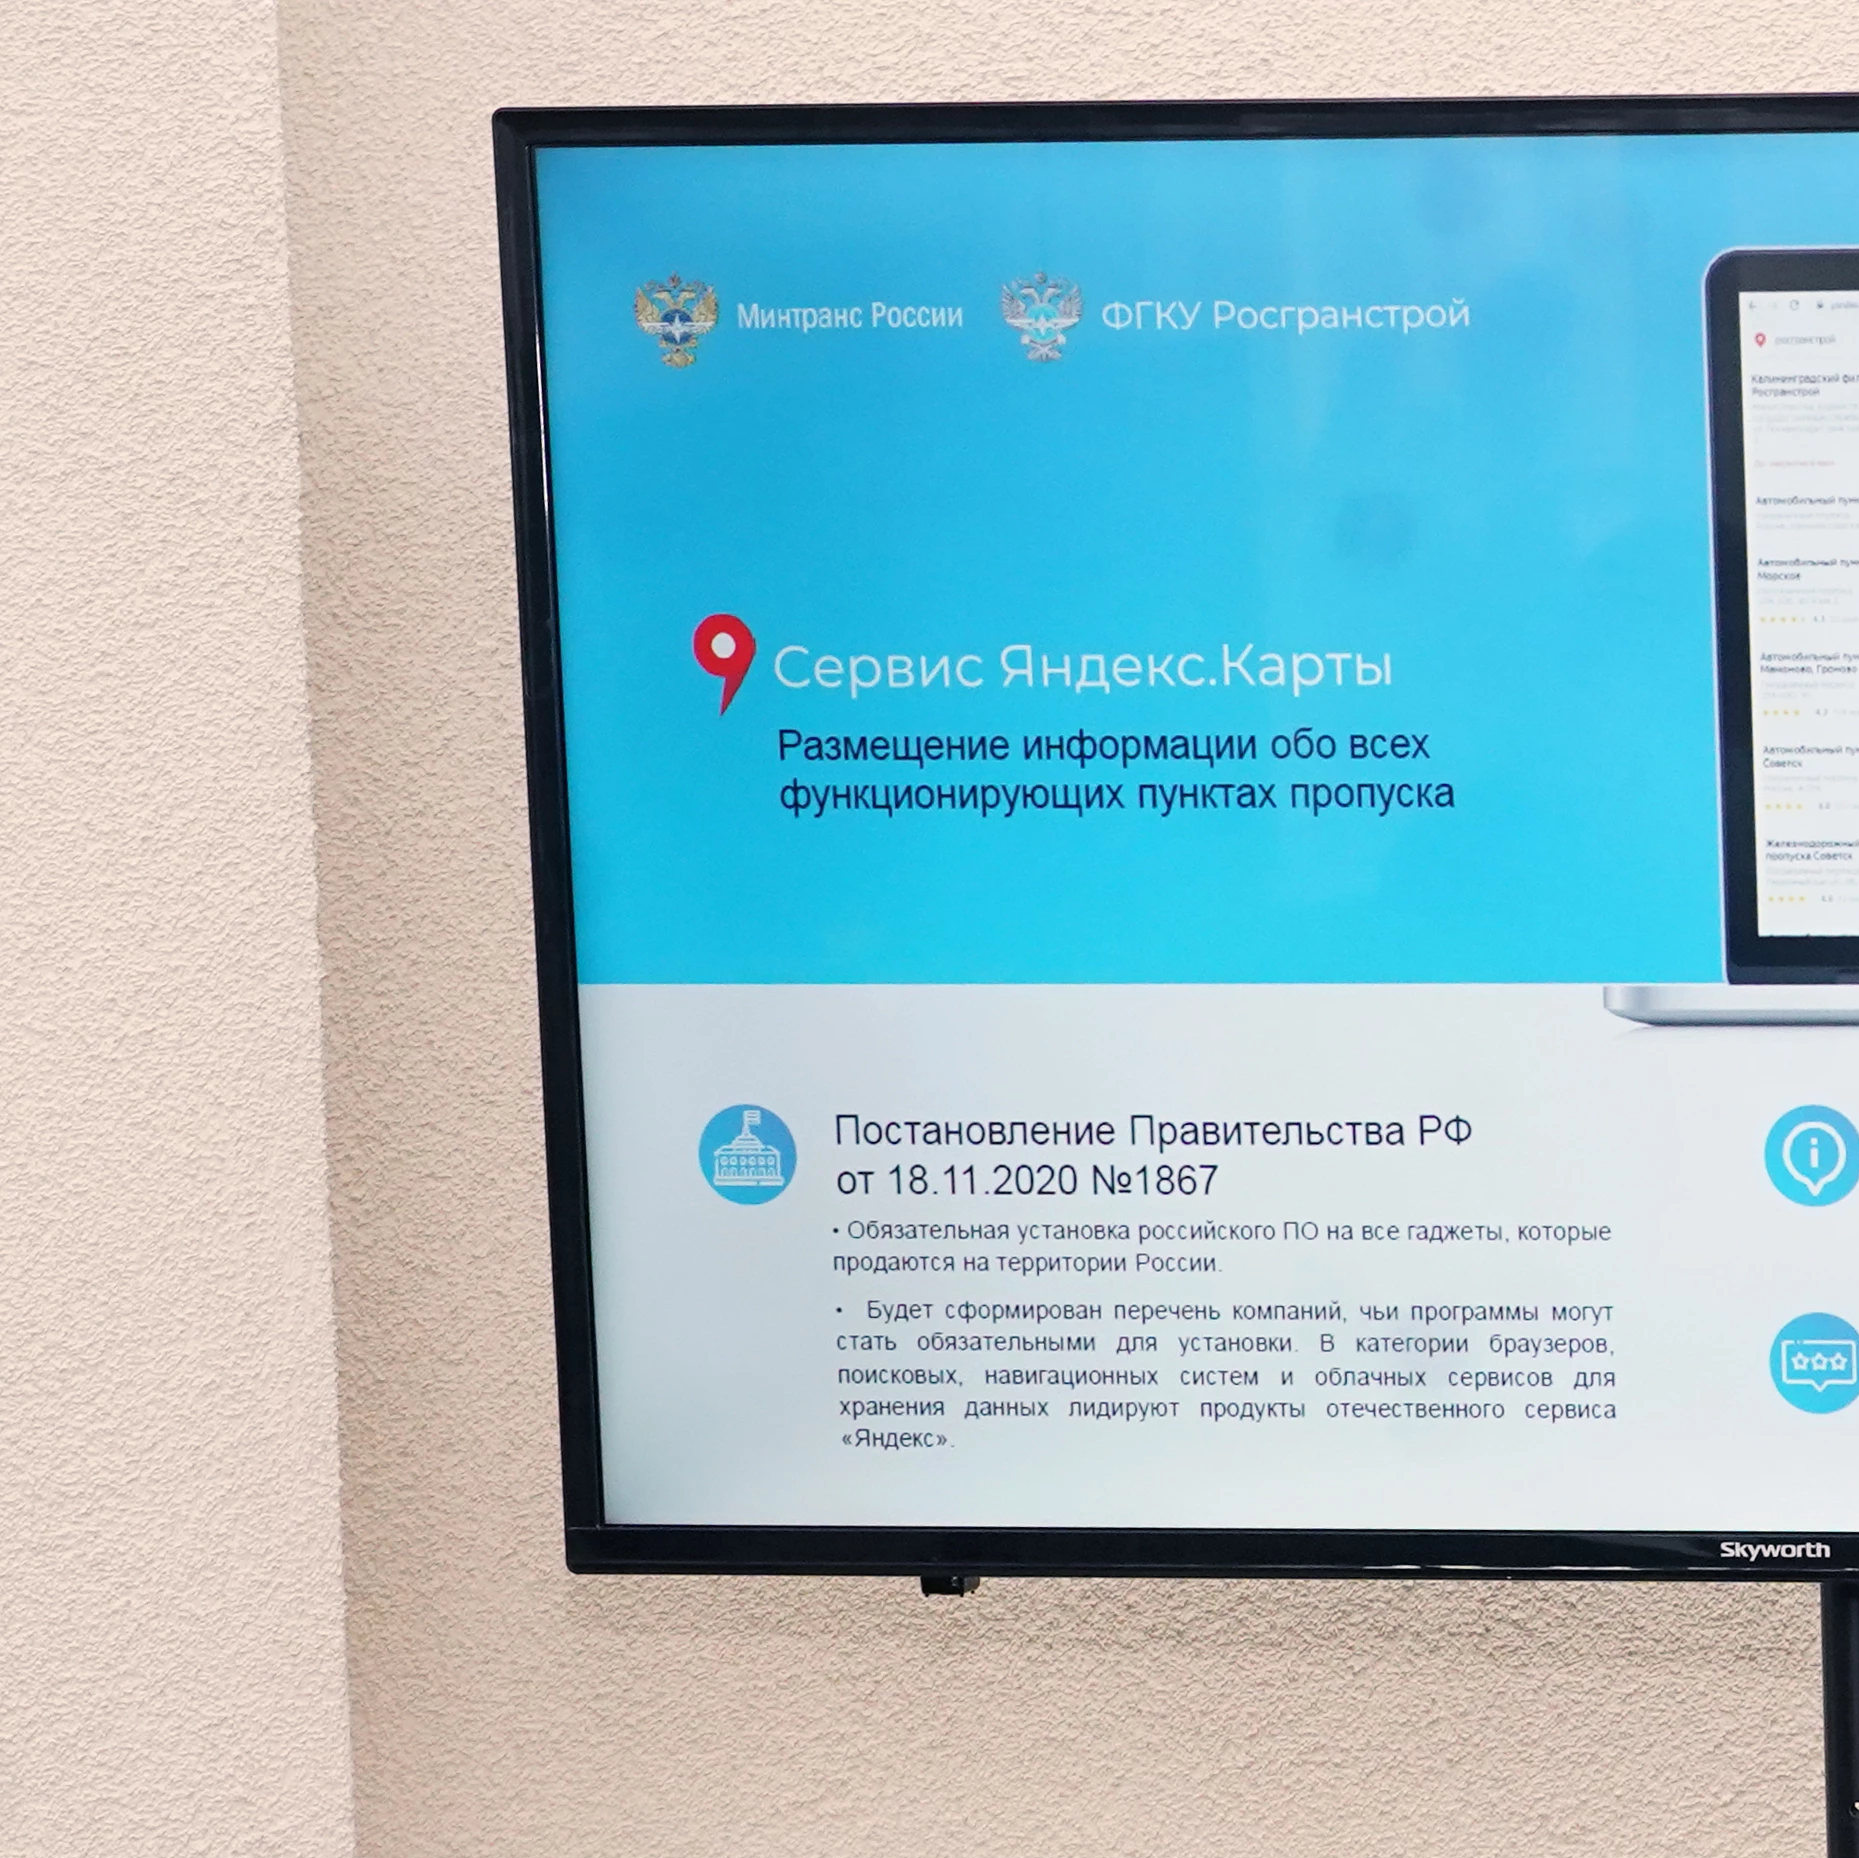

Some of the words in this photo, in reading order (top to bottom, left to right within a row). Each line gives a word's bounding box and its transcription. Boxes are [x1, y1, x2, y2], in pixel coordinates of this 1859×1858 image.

[737, 302, 863, 334] Минтранс
[871, 301, 964, 328] России
[1102, 300, 1202, 331] ФГКУ
[1214, 297, 1470, 334] Росгранстрой
[1751, 373, 1839, 386] Калининградский
[1755, 495, 1836, 506] Автомобильный
[1757, 557, 1838, 567] Автомобильный
[1757, 571, 1801, 581] Морское
[1759, 651, 1841, 663] Автомобильный
[774, 645, 984, 699] Сервис
[1000, 642, 1392, 698] Яндекс.Карты
[778, 728, 1010, 770] Размещение
[1023, 728, 1257, 769] информации
[1271, 727, 1337, 760] обо
[1350, 734, 1431, 759] всех
[1762, 744, 1843, 755] Автомобильный
[1762, 757, 1803, 769] Советск
[779, 777, 1125, 819] функционирующих
[1138, 783, 1277, 818] пунктах
[1291, 783, 1455, 817] пропуска
[1765, 851, 1812, 862] пропуска
[1813, 850, 1853, 861] Советск
[835, 1113, 1116, 1146] Постановление
[1130, 1114, 1405, 1155] Правительства
[1419, 1114, 1472, 1146] РФ
[837, 1170, 875, 1195] от
[889, 1163, 1078, 1196] 18.11.2020
[1092, 1164, 1219, 1196] №1867
[847, 1220, 1010, 1240] Обязательная
[1016, 1224, 1130, 1245] установка
[1138, 1219, 1276, 1246] российского
[1283, 1221, 1319, 1241] ПО
[1327, 1224, 1354, 1241] на
[1361, 1224, 1400, 1241] все
[1407, 1224, 1510, 1244] гаджеты,
[1518, 1225, 1612, 1246] которые
[833, 1255, 955, 1277] продаются
[963, 1255, 990, 1272] на
[995, 1255, 1127, 1277] территории
[1135, 1252, 1222, 1273] России.
[867, 1299, 934, 1325] Будет
[944, 1300, 1102, 1325] сформирован
[1114, 1304, 1221, 1325] перечень
[1232, 1300, 1347, 1323] компаний,
[1359, 1305, 1399, 1321] чьи
[1411, 1305, 1539, 1326] программы
[1552, 1305, 1614, 1327] могут
[836, 1334, 897, 1351] стать
[917, 1331, 1096, 1352] обязательными
[1115, 1336, 1158, 1355] для
[1178, 1336, 1298, 1357] установки.
[1320, 1333, 1335, 1353] В
[1356, 1336, 1469, 1358] категории
[1489, 1333, 1614, 1358] браузеров,
[837, 1368, 963, 1387] поисковых,
[984, 1368, 1159, 1390] навигационных
[1180, 1369, 1259, 1386] систем
[1281, 1370, 1294, 1386] и
[1315, 1367, 1427, 1387] облачных
[1448, 1371, 1553, 1392] сервисов
[1573, 1371, 1616, 1390] для
[839, 1400, 945, 1421] хранения
[963, 1400, 1049, 1420] данных
[1068, 1401, 1180, 1423] лидируют
[1200, 1401, 1305, 1423] продукты
[1326, 1402, 1505, 1419] отечественного
[1524, 1403, 1617, 1424] сервиса
[841, 1428, 954, 1451] «Яндекс».
[1720, 1541, 1831, 1562] Skyworth
